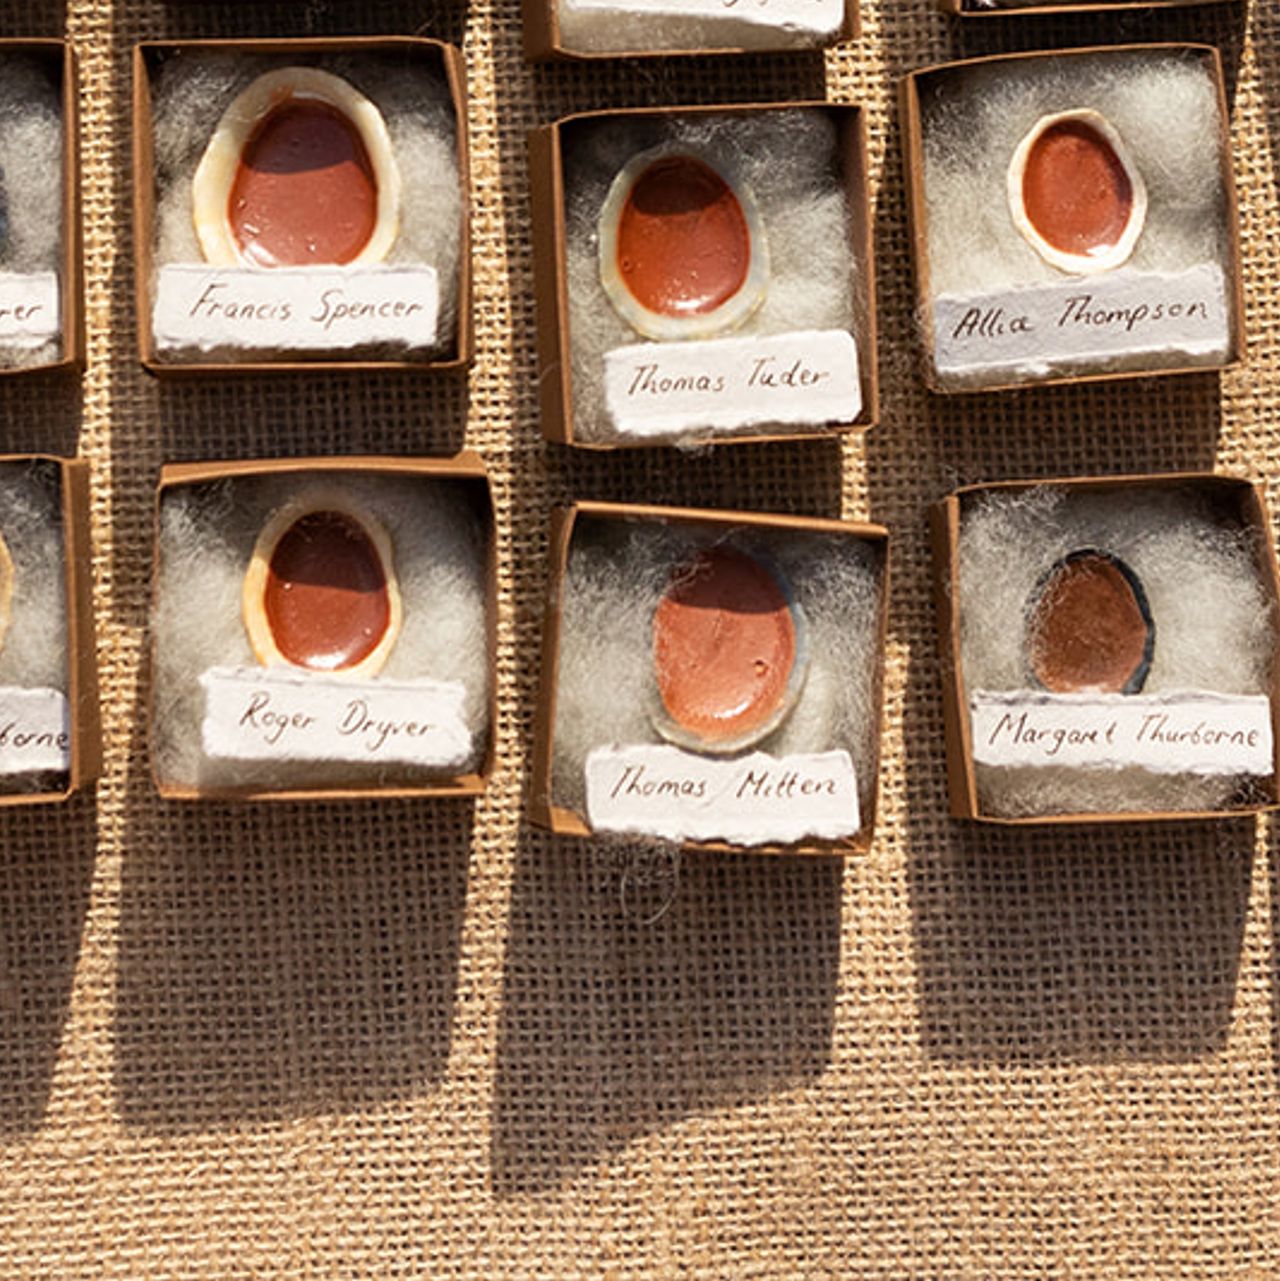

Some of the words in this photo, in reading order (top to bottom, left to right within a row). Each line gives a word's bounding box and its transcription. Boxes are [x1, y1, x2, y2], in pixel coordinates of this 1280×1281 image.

[188, 284, 291, 320] Francis
[312, 290, 423, 327] Spencer
[1058, 295, 1208, 330] Thompson
[627, 364, 724, 396] Thomas
[748, 360, 829, 388] Tuder
[239, 693, 316, 744] Roger
[989, 714, 1115, 754] Margaret
[611, 768, 705, 798] Thomas
[736, 768, 835, 798] Mitten
